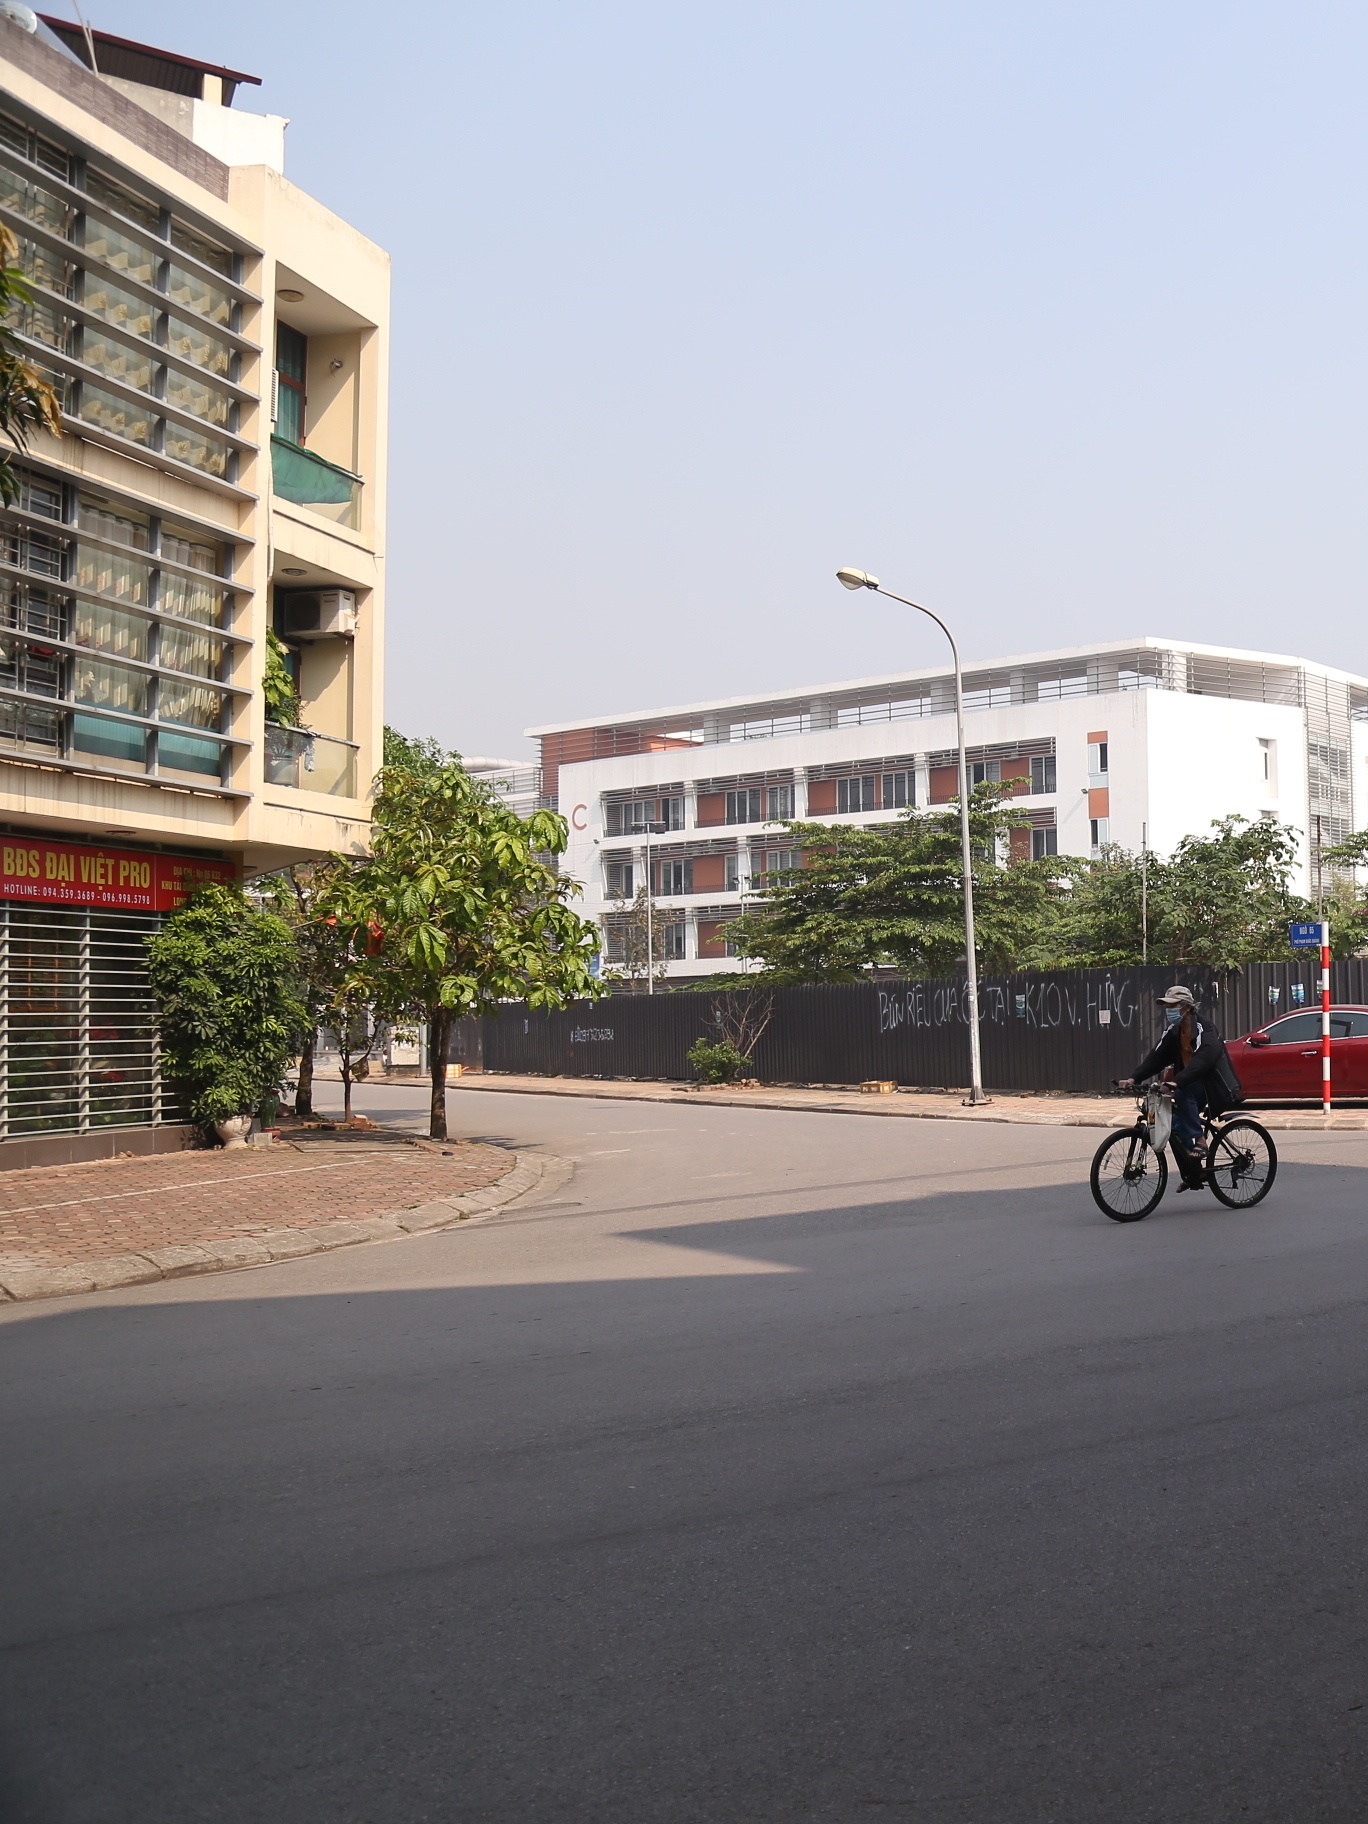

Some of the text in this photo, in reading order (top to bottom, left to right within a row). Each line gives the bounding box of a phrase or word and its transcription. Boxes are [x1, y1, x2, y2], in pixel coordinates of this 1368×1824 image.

[572, 803, 588, 831] C
[3, 847, 151, 890] BĐS ĐẠI VIỆT PRO
[3, 883, 151, 905] HOTLINE: 094.359.3689 096.998.5798
[161, 880, 172, 890] KHU
[934, 986, 961, 1026] CUA
